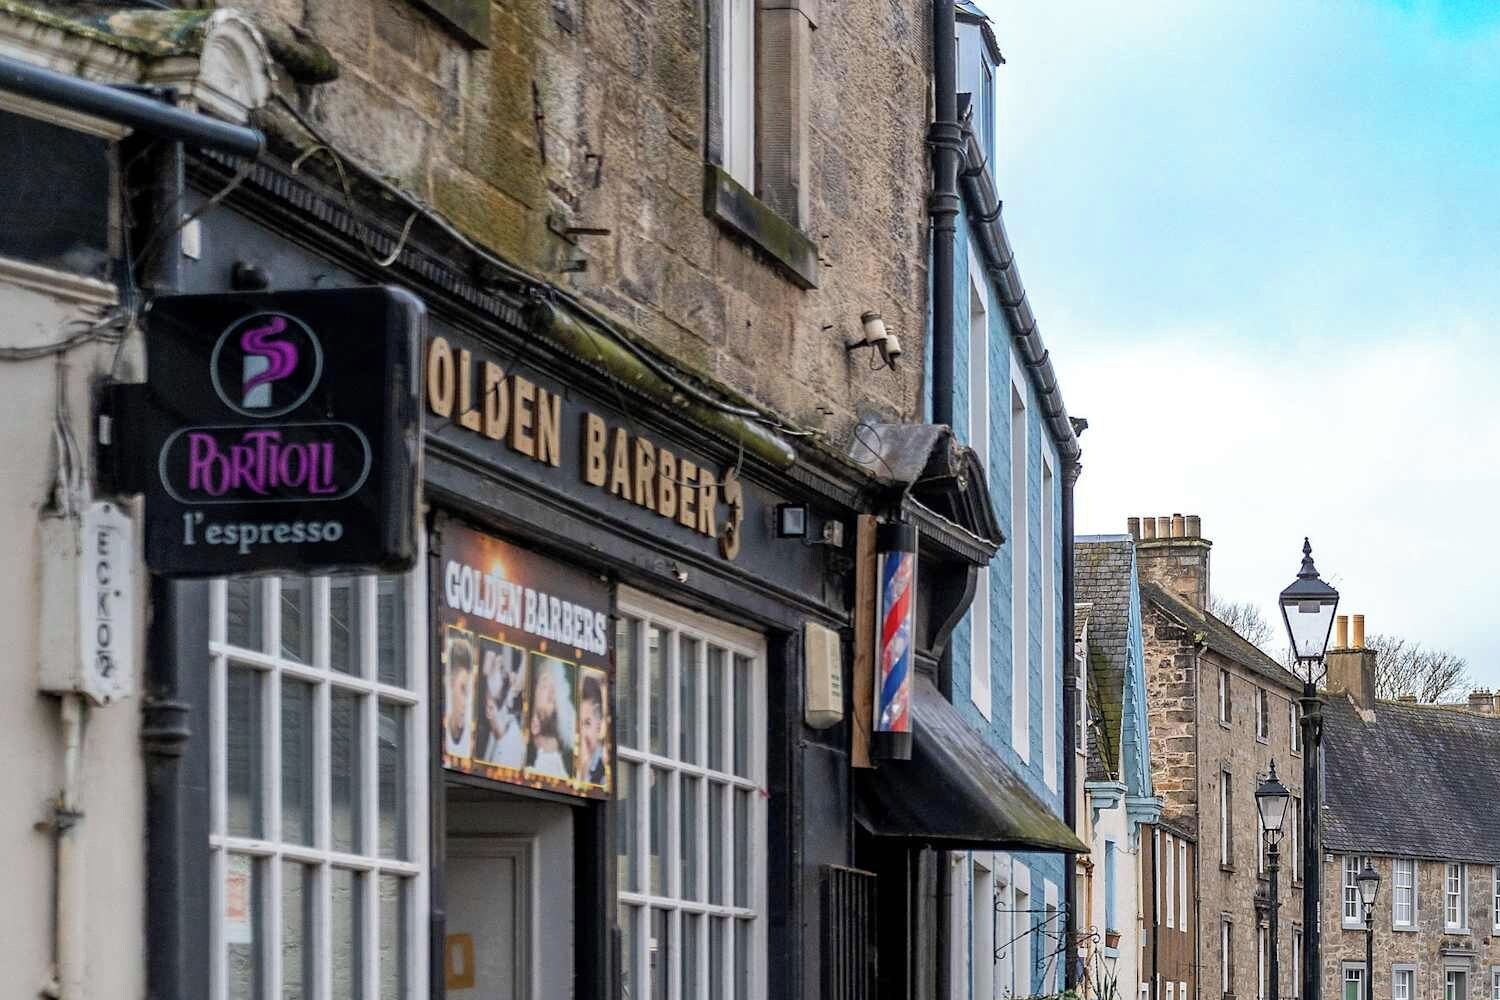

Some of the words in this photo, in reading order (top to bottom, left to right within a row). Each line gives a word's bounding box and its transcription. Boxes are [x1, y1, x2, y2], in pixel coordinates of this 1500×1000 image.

[183, 511, 343, 555] l'espresso
[445, 560, 523, 629] GOLDEN
[524, 588, 608, 656] BARBERS
